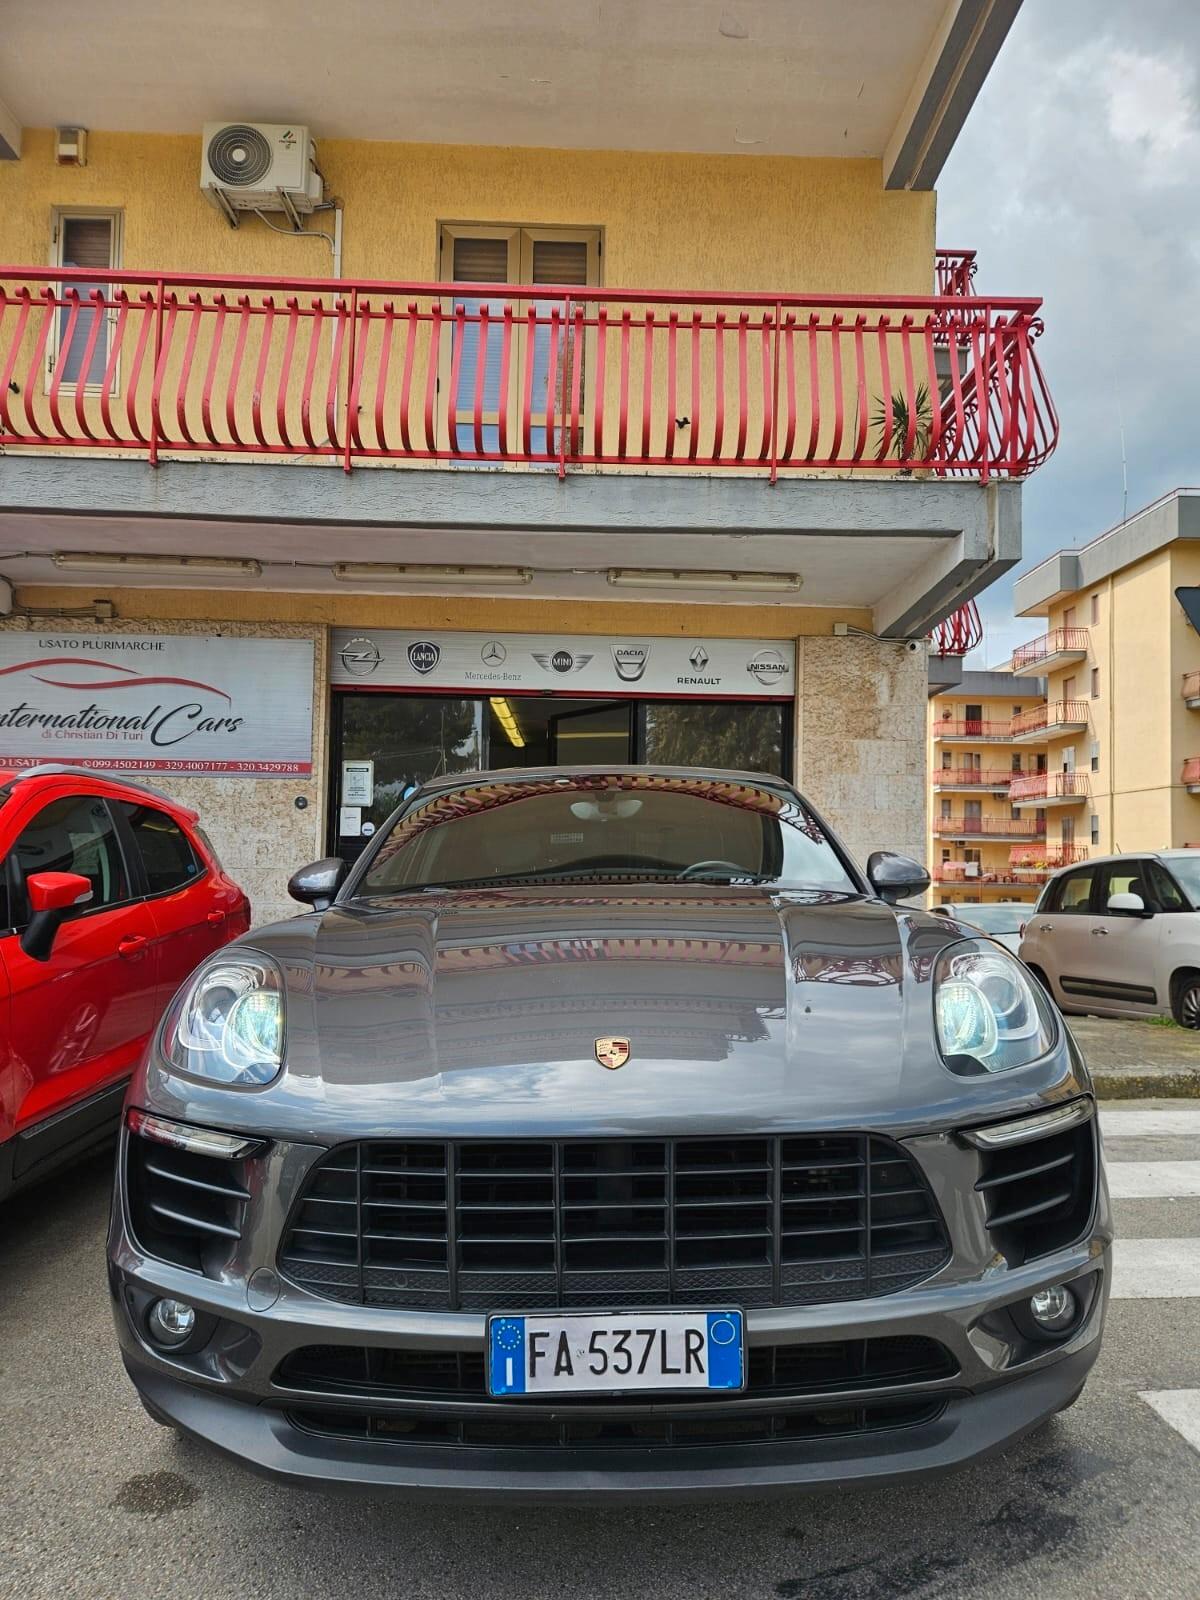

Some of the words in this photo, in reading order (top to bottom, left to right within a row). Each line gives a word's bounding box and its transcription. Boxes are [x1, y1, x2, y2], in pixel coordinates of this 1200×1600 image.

[38, 639, 79, 650] USATO
[82, 640, 166, 651] PLURIMARCHE
[412, 651, 435, 662] LANCIA
[552, 657, 573, 668] MINI
[750, 663, 786, 671] NISSAN
[464, 671, 522, 681] Mercedes-Benz
[677, 677, 722, 686] RENAULT
[150, 703, 244, 747] Cars
[41, 729, 52, 739] di
[55, 729, 103, 740] Christian
[106, 730, 118, 740] Di
[122, 731, 144, 741] Turi
[92, 760, 156, 769] 099.4502149
[164, 761, 228, 770] 329.4007177
[238, 762, 299, 772] 320.3429788
